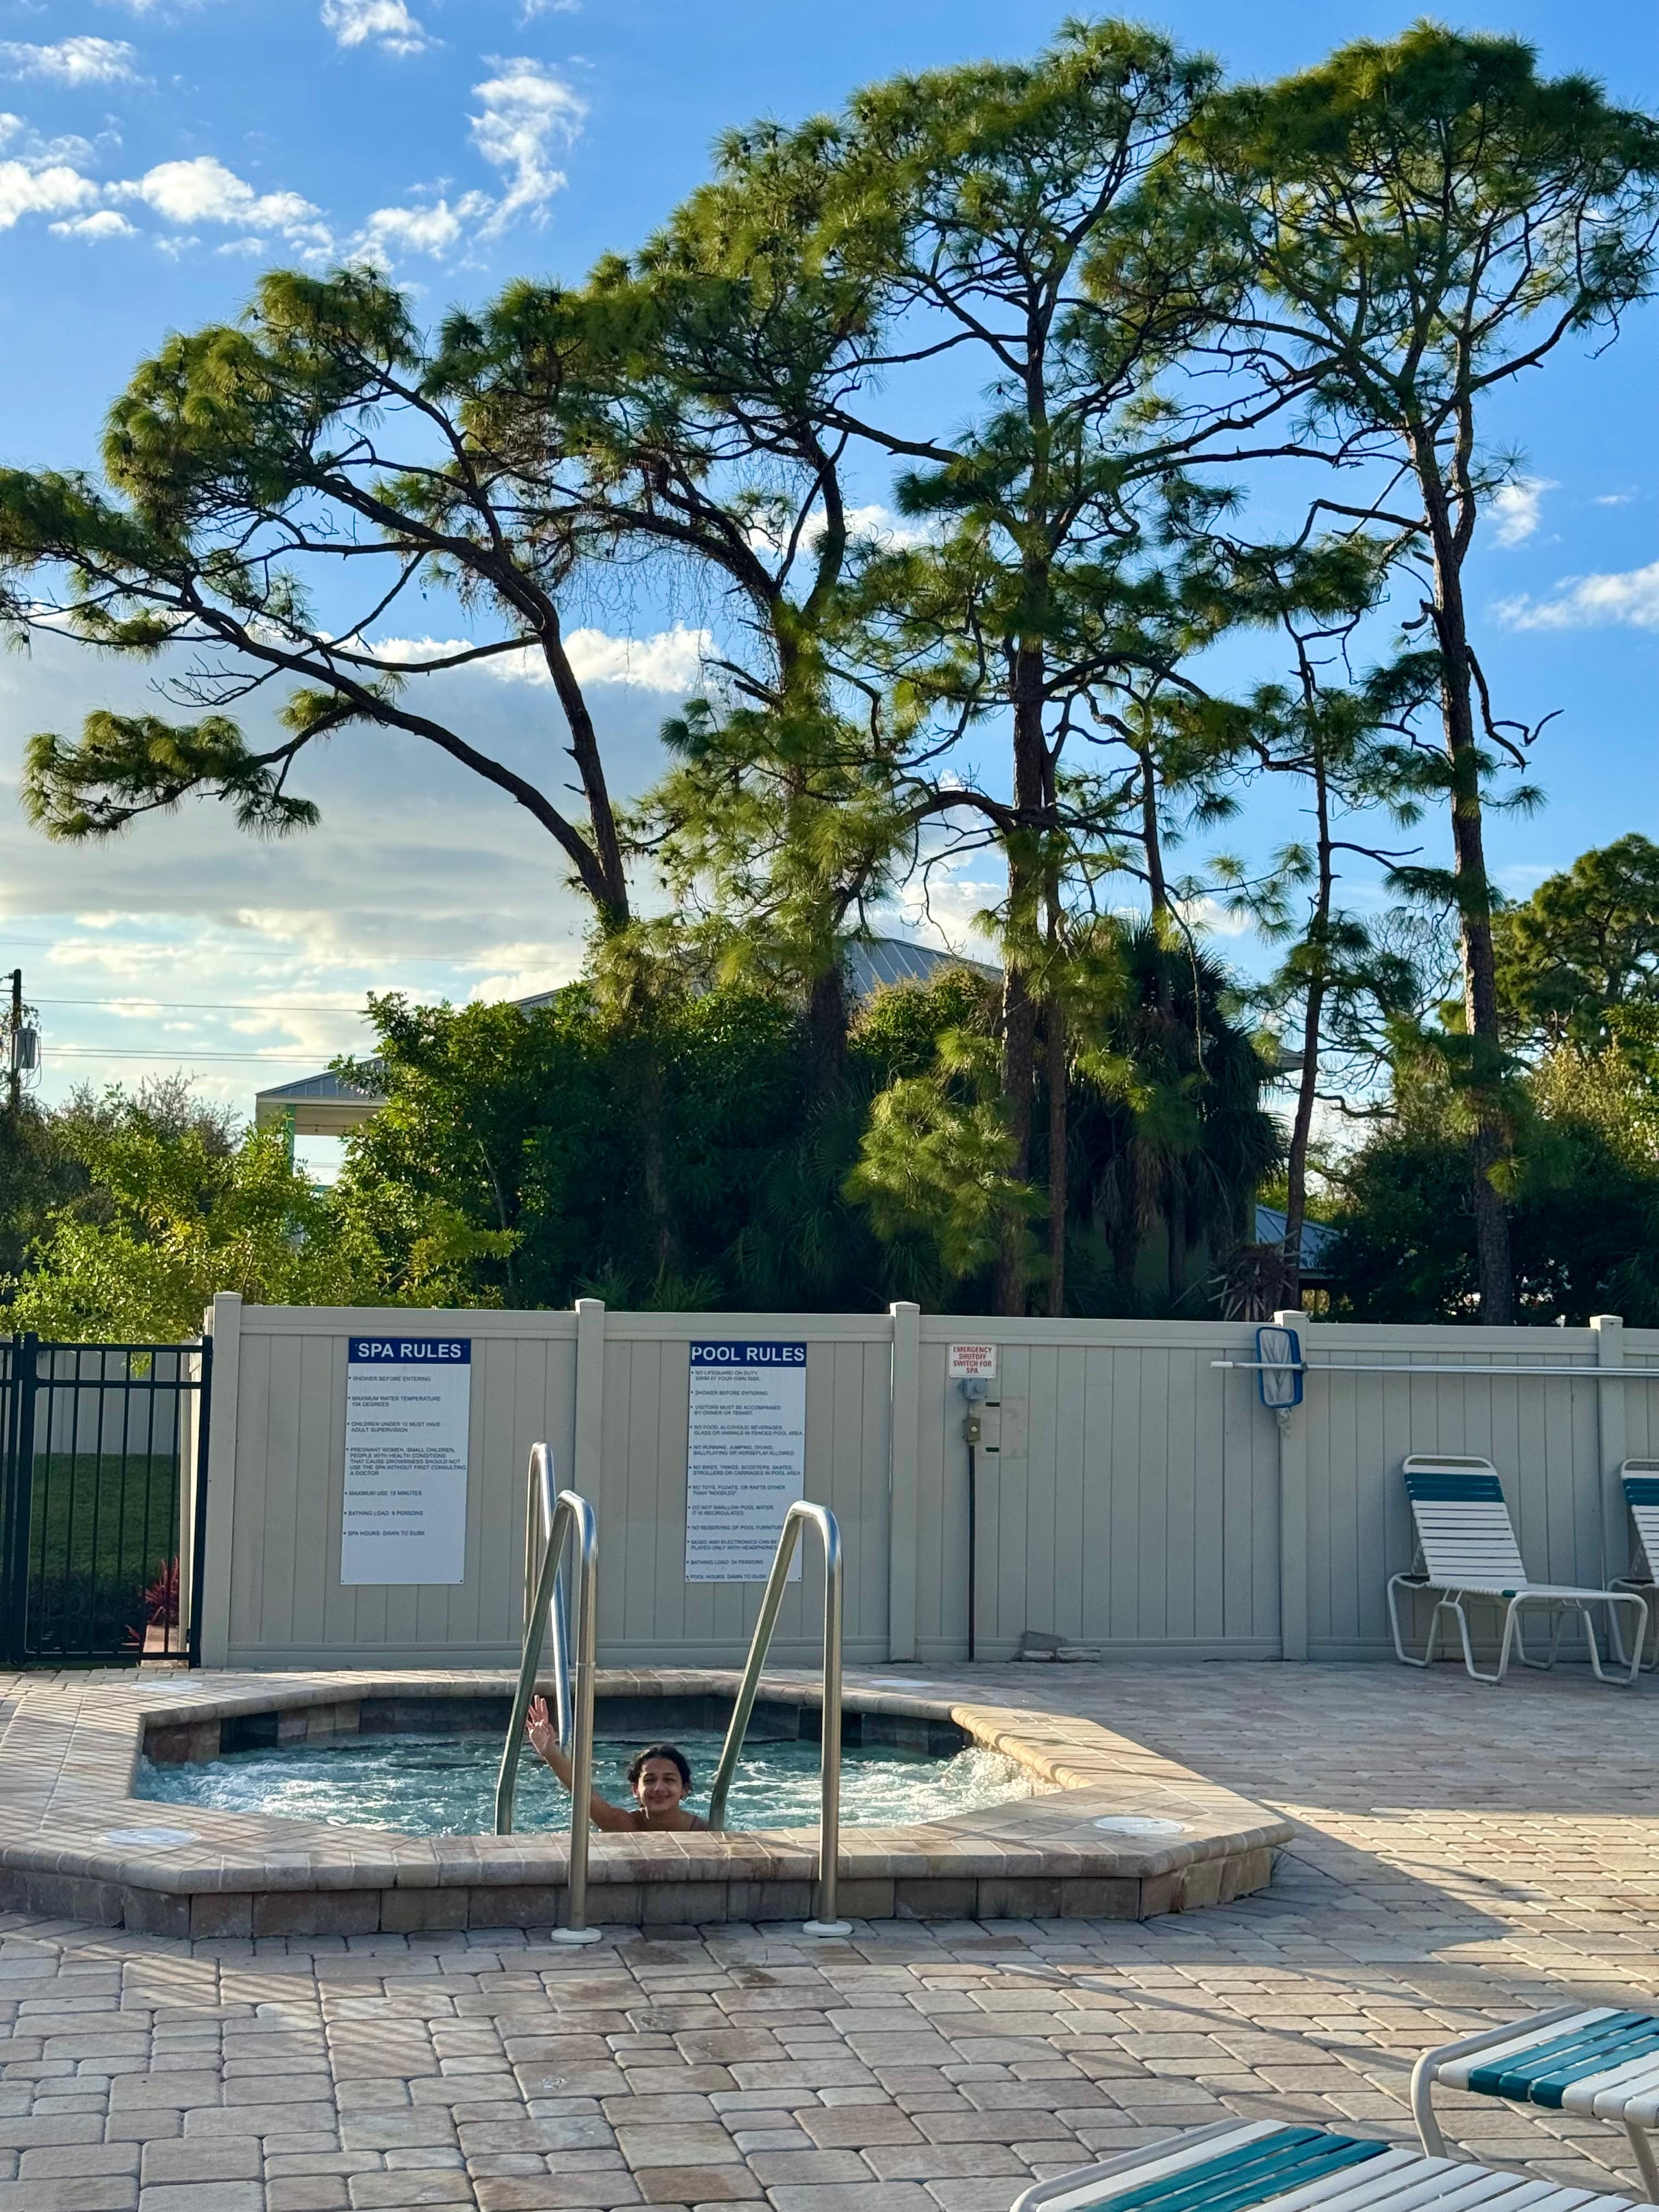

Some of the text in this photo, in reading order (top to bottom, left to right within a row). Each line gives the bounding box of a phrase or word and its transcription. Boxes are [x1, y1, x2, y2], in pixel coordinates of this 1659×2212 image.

[358, 1344, 461, 1358] SPA RULES
[691, 1347, 805, 1361] POOL RULES
